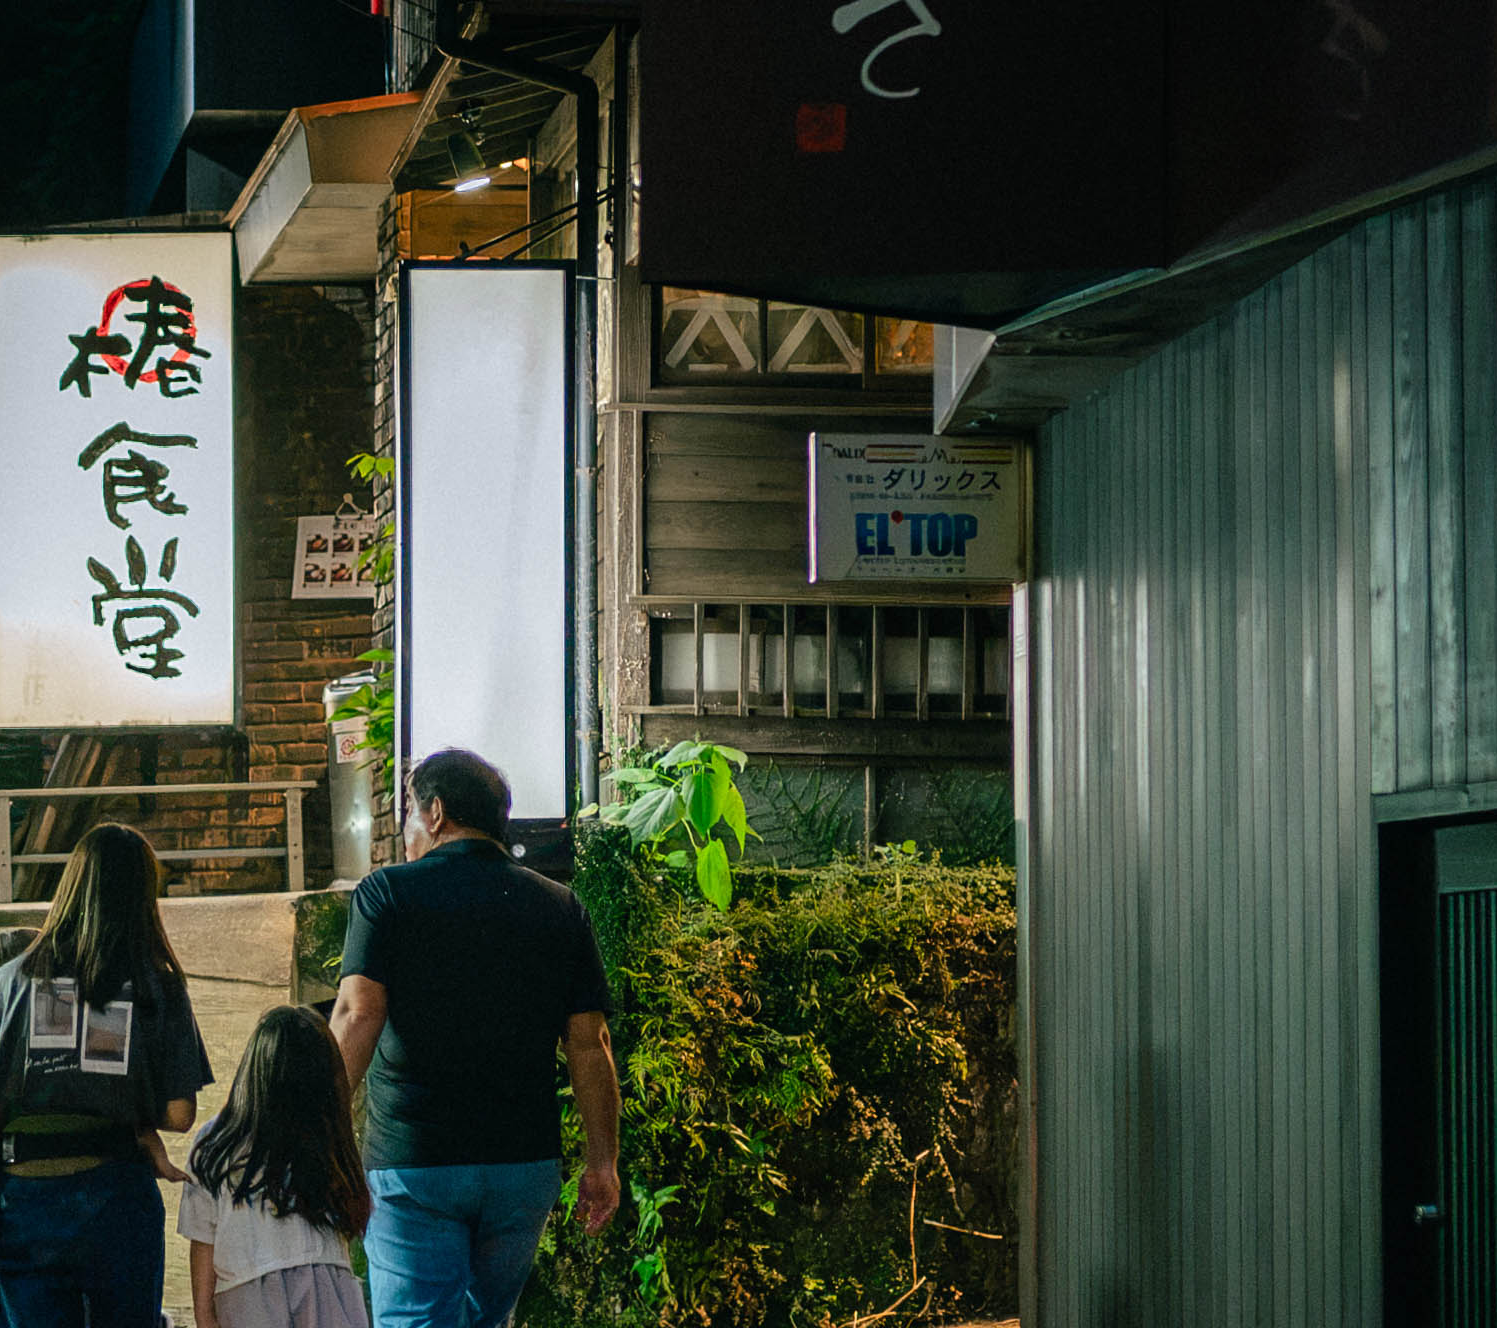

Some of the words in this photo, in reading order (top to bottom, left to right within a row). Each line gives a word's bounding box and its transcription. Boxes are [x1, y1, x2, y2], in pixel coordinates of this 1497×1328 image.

[59, 275, 211, 677] 椿食堂
[883, 467, 1002, 491] ダリックス
